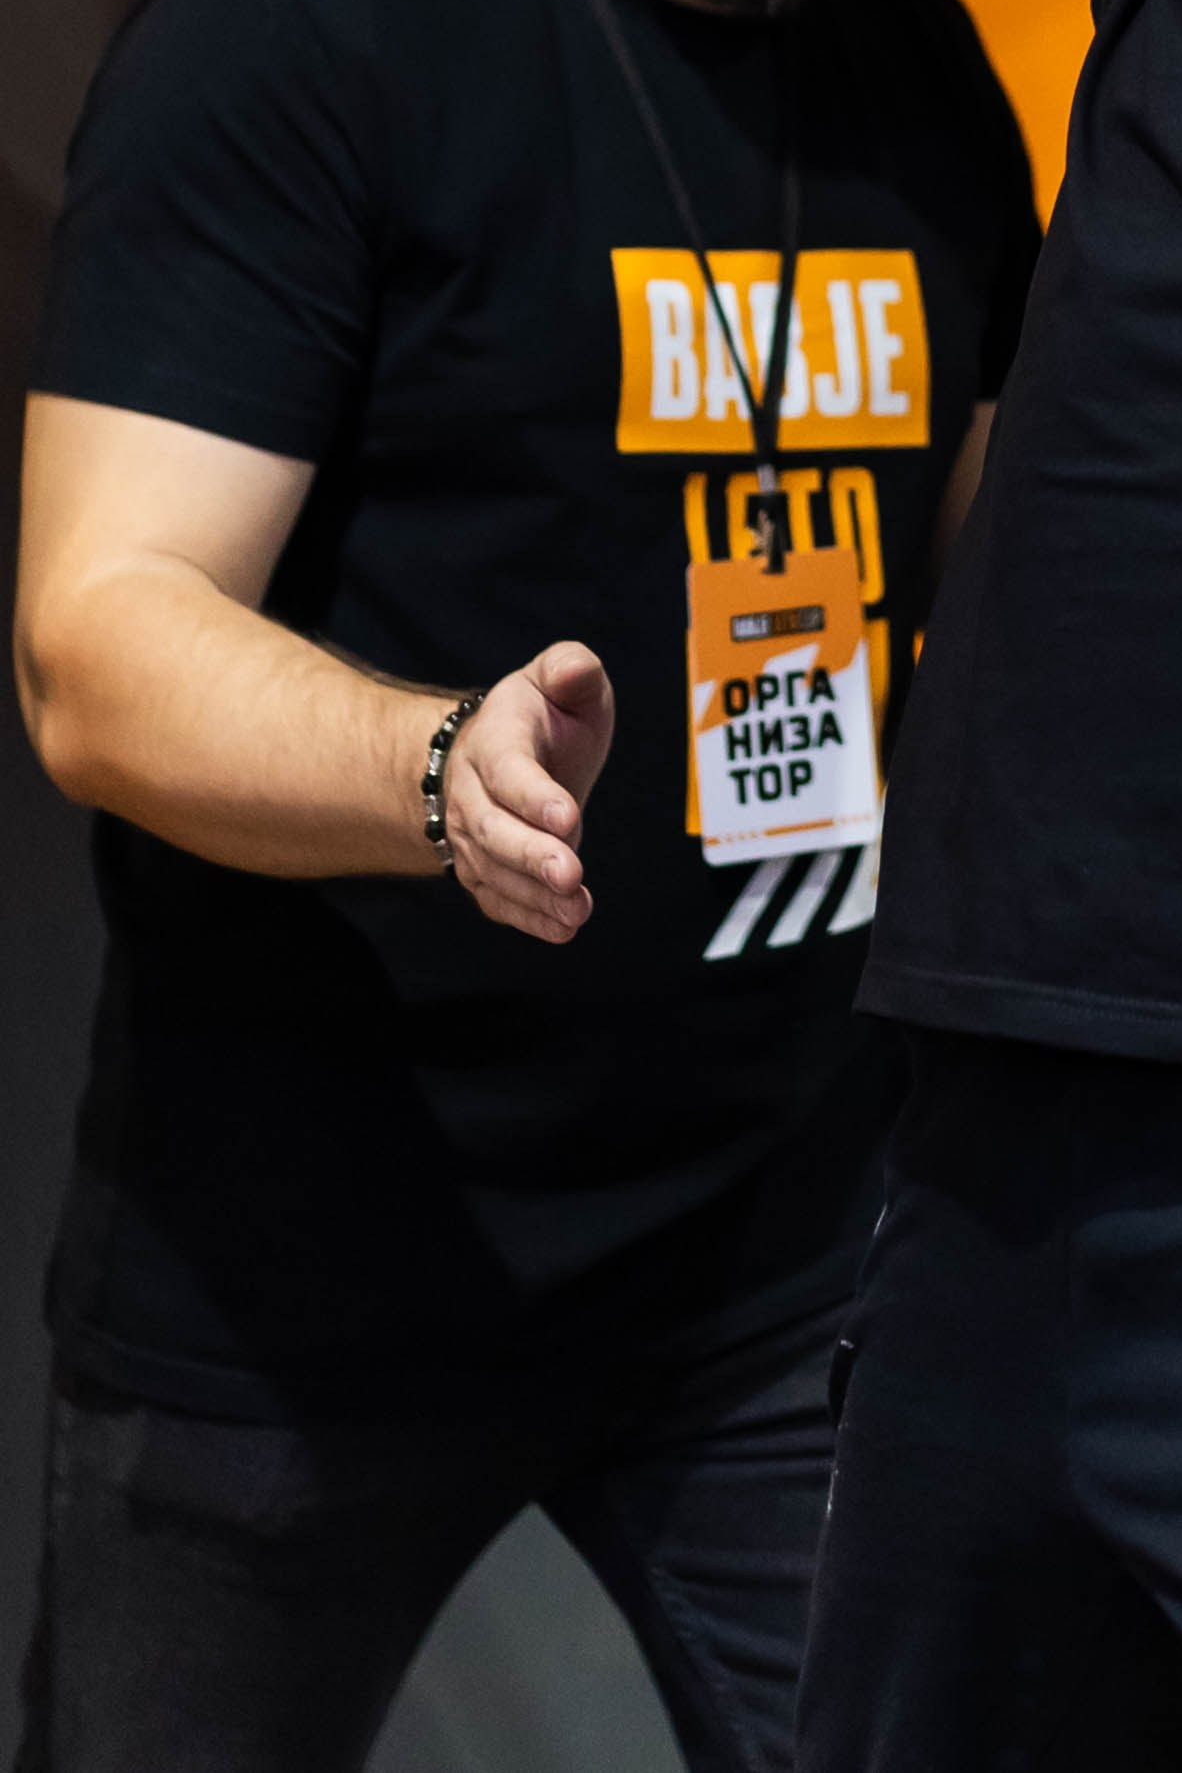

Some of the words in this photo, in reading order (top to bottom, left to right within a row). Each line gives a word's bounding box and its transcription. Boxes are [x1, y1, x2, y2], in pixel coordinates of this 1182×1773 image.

[723, 667, 836, 717] ОРГА
[724, 710, 844, 762] НИЗА
[728, 759, 813, 805] ТОР
